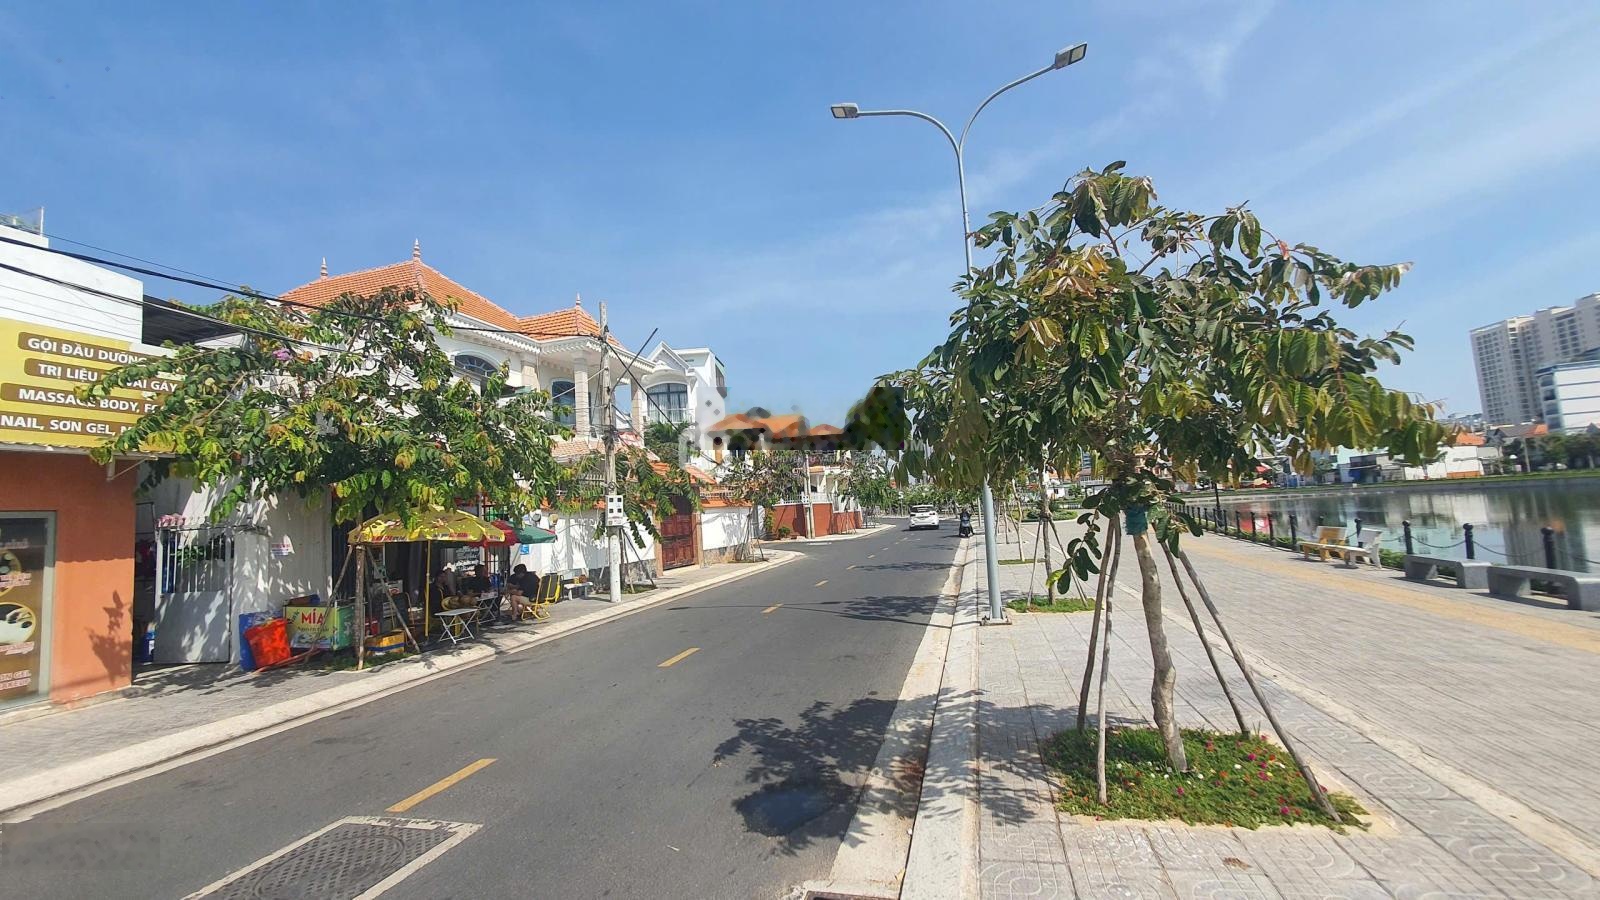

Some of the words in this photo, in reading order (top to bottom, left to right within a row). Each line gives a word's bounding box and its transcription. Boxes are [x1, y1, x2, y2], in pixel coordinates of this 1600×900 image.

[27, 338, 57, 353] GỘI
[61, 342, 94, 358] ĐẦU
[38, 363, 62, 380] TRỊ
[66, 368, 98, 383] LIỆU
[99, 398, 140, 413] BODY,
[0, 414, 45, 430] NAIL,
[50, 419, 82, 433] SƠN
[86, 423, 116, 436] GEL,
